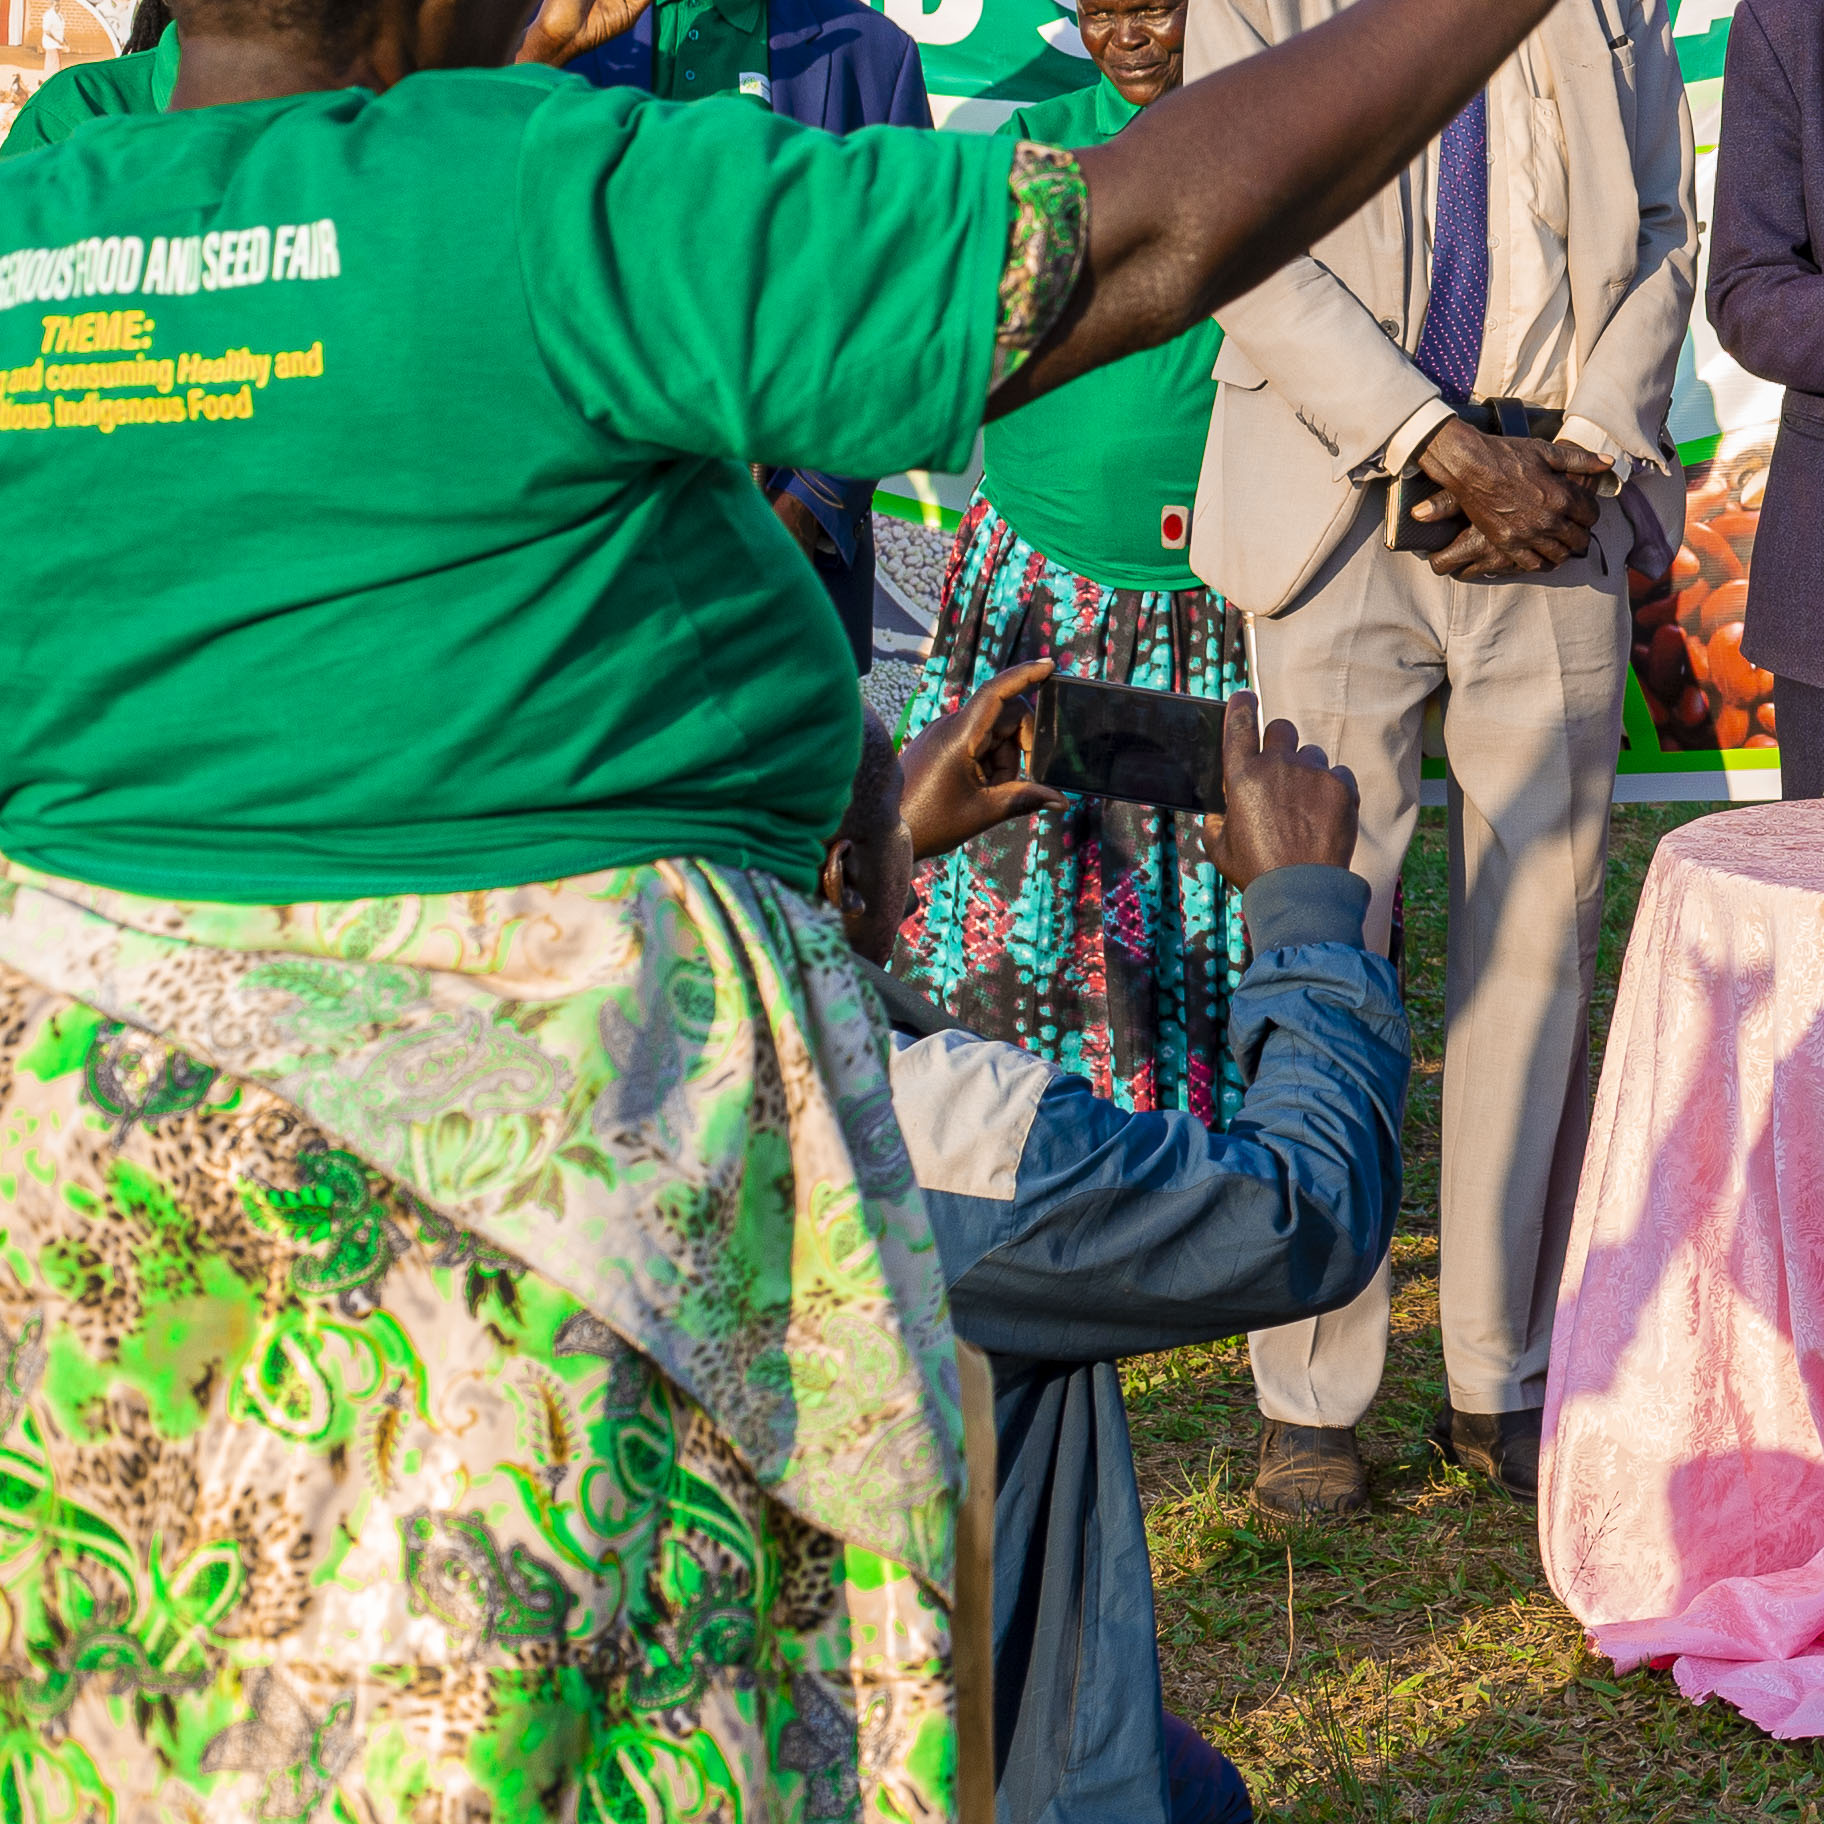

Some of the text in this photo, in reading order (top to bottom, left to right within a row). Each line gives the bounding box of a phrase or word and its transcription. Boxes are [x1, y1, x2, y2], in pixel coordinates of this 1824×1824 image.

[72, 236, 144, 297] FOOD
[142, 235, 202, 294] AND
[202, 225, 271, 291] SEED
[272, 218, 340, 281] FAIR
[40, 309, 156, 354] THEME:
[44, 352, 175, 395] consuming
[176, 346, 273, 389] Healthy
[274, 340, 324, 380] and
[54, 390, 187, 434] Indigenous
[187, 383, 254, 421] Food
